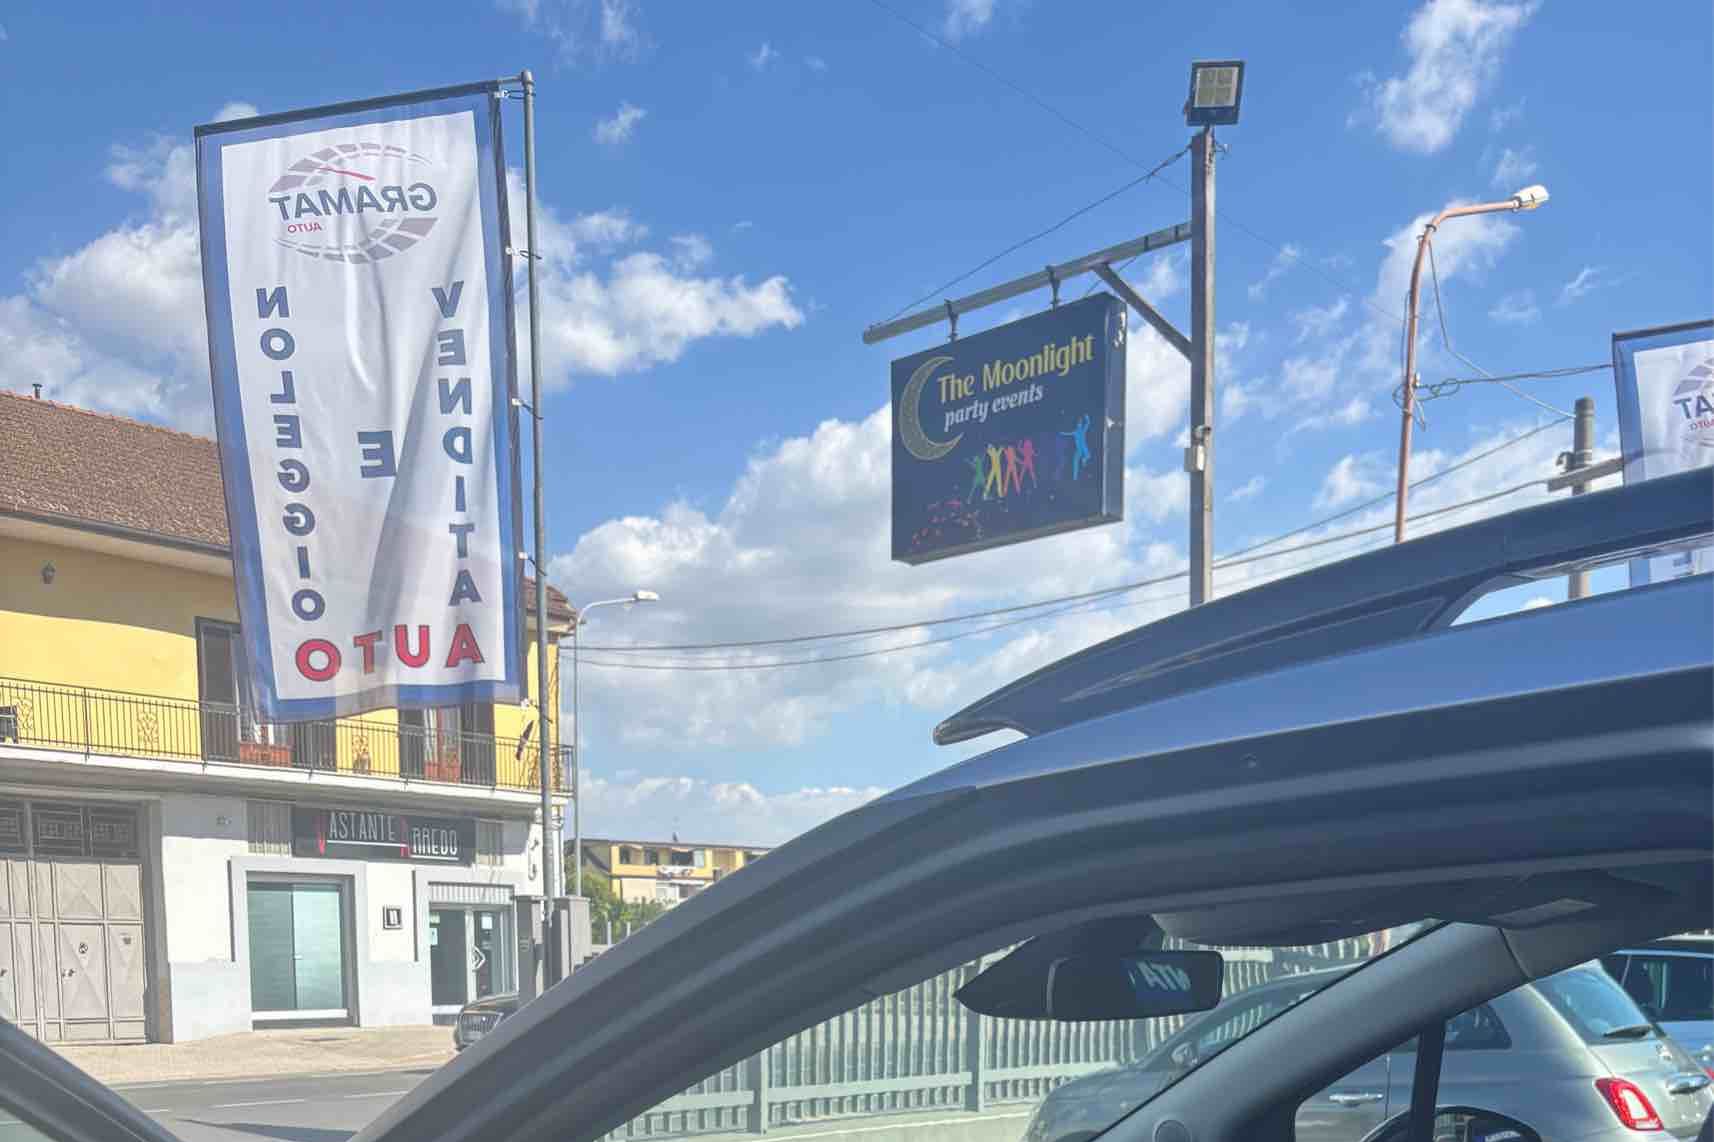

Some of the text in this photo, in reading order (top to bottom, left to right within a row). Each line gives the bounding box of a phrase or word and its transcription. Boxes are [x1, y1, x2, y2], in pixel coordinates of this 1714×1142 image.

[937, 334, 1095, 403] The Moonlight
[943, 384, 1043, 432] party events
